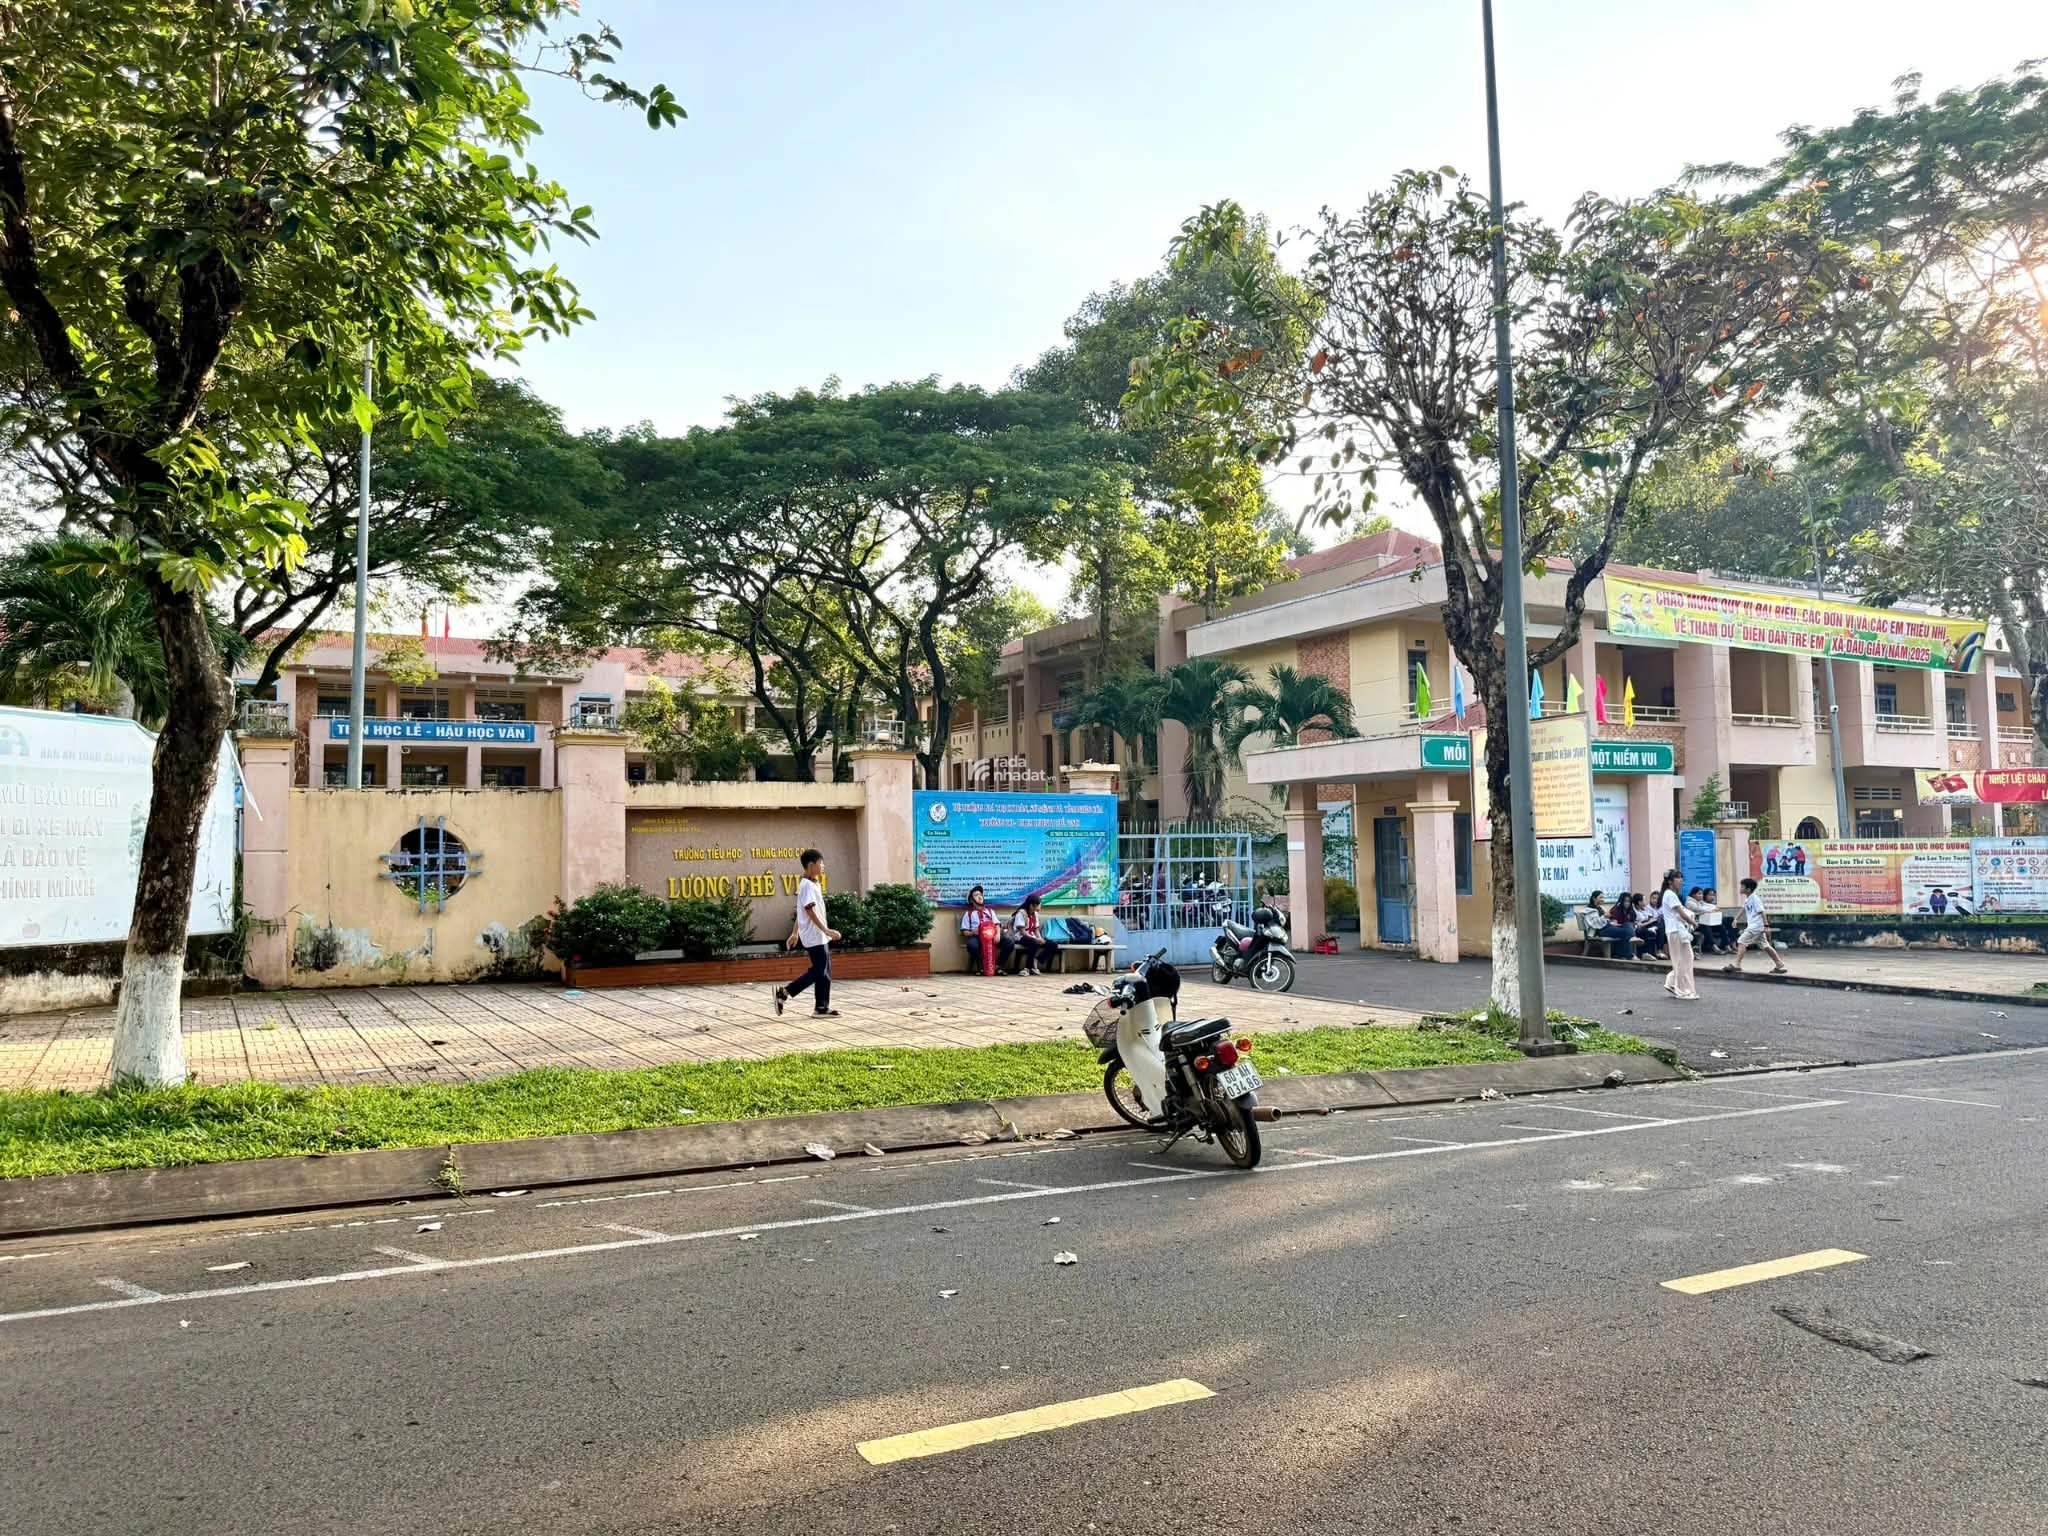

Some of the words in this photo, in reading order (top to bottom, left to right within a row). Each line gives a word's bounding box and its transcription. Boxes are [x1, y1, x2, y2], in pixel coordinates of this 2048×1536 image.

[1802, 608, 1821, 625] CÁC
[1824, 611, 1842, 627] ĐƠN
[1845, 613, 1854, 631] VỊ
[1856, 614, 1868, 630] VÀ
[1871, 616, 1888, 633] CÁC
[1890, 620, 1904, 635] EM
[1690, 619, 1718, 638] THAM
[1910, 647, 1930, 662] 2025
[337, 724, 369, 736] TIN
[373, 725, 402, 738] HỌC
[436, 725, 464, 740] HẬU
[467, 727, 495, 741] HỌC
[498, 726, 525, 739] VĂN
[1443, 741, 1466, 761] MỖI
[1591, 748, 1610, 769] MỘT
[1641, 752, 1657, 767] VUI
[2011, 771, 2025, 787] LIỆT
[22, 842, 58, 867] BẢO
[726, 847, 742, 863] HỌC
[751, 847, 776, 860] TRUNG
[1540, 841, 1554, 858] BẢO
[1556, 840, 1575, 858] HIỂM
[1543, 867, 1552, 881] XE
[1554, 864, 1568, 881] MÁY
[48, 873, 96, 899] MÌNH
